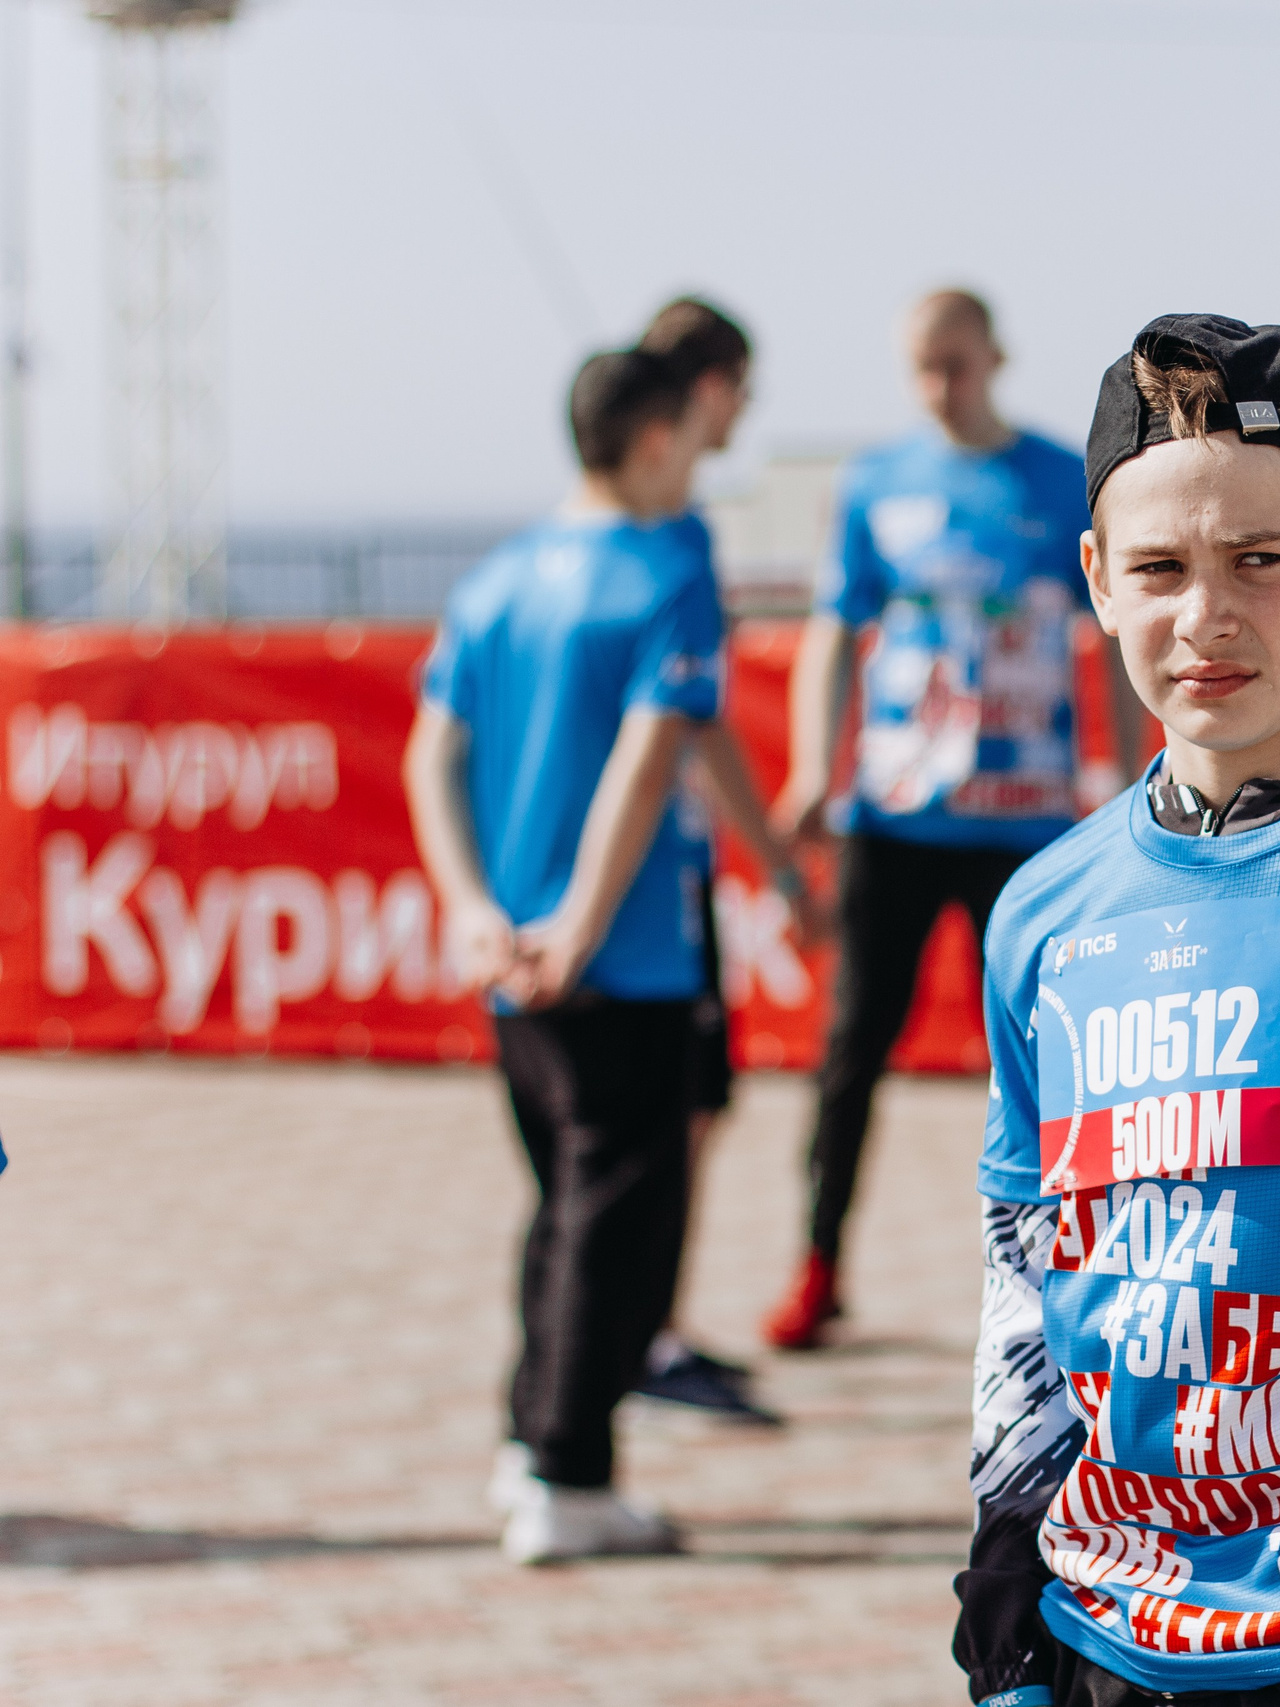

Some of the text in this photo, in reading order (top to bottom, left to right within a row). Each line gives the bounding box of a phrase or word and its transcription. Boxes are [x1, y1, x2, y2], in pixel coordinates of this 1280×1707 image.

[1079, 932, 1117, 959] ПСБ
[1086, 985, 1260, 1095] 00512
[1111, 1091, 1193, 1181] 500
